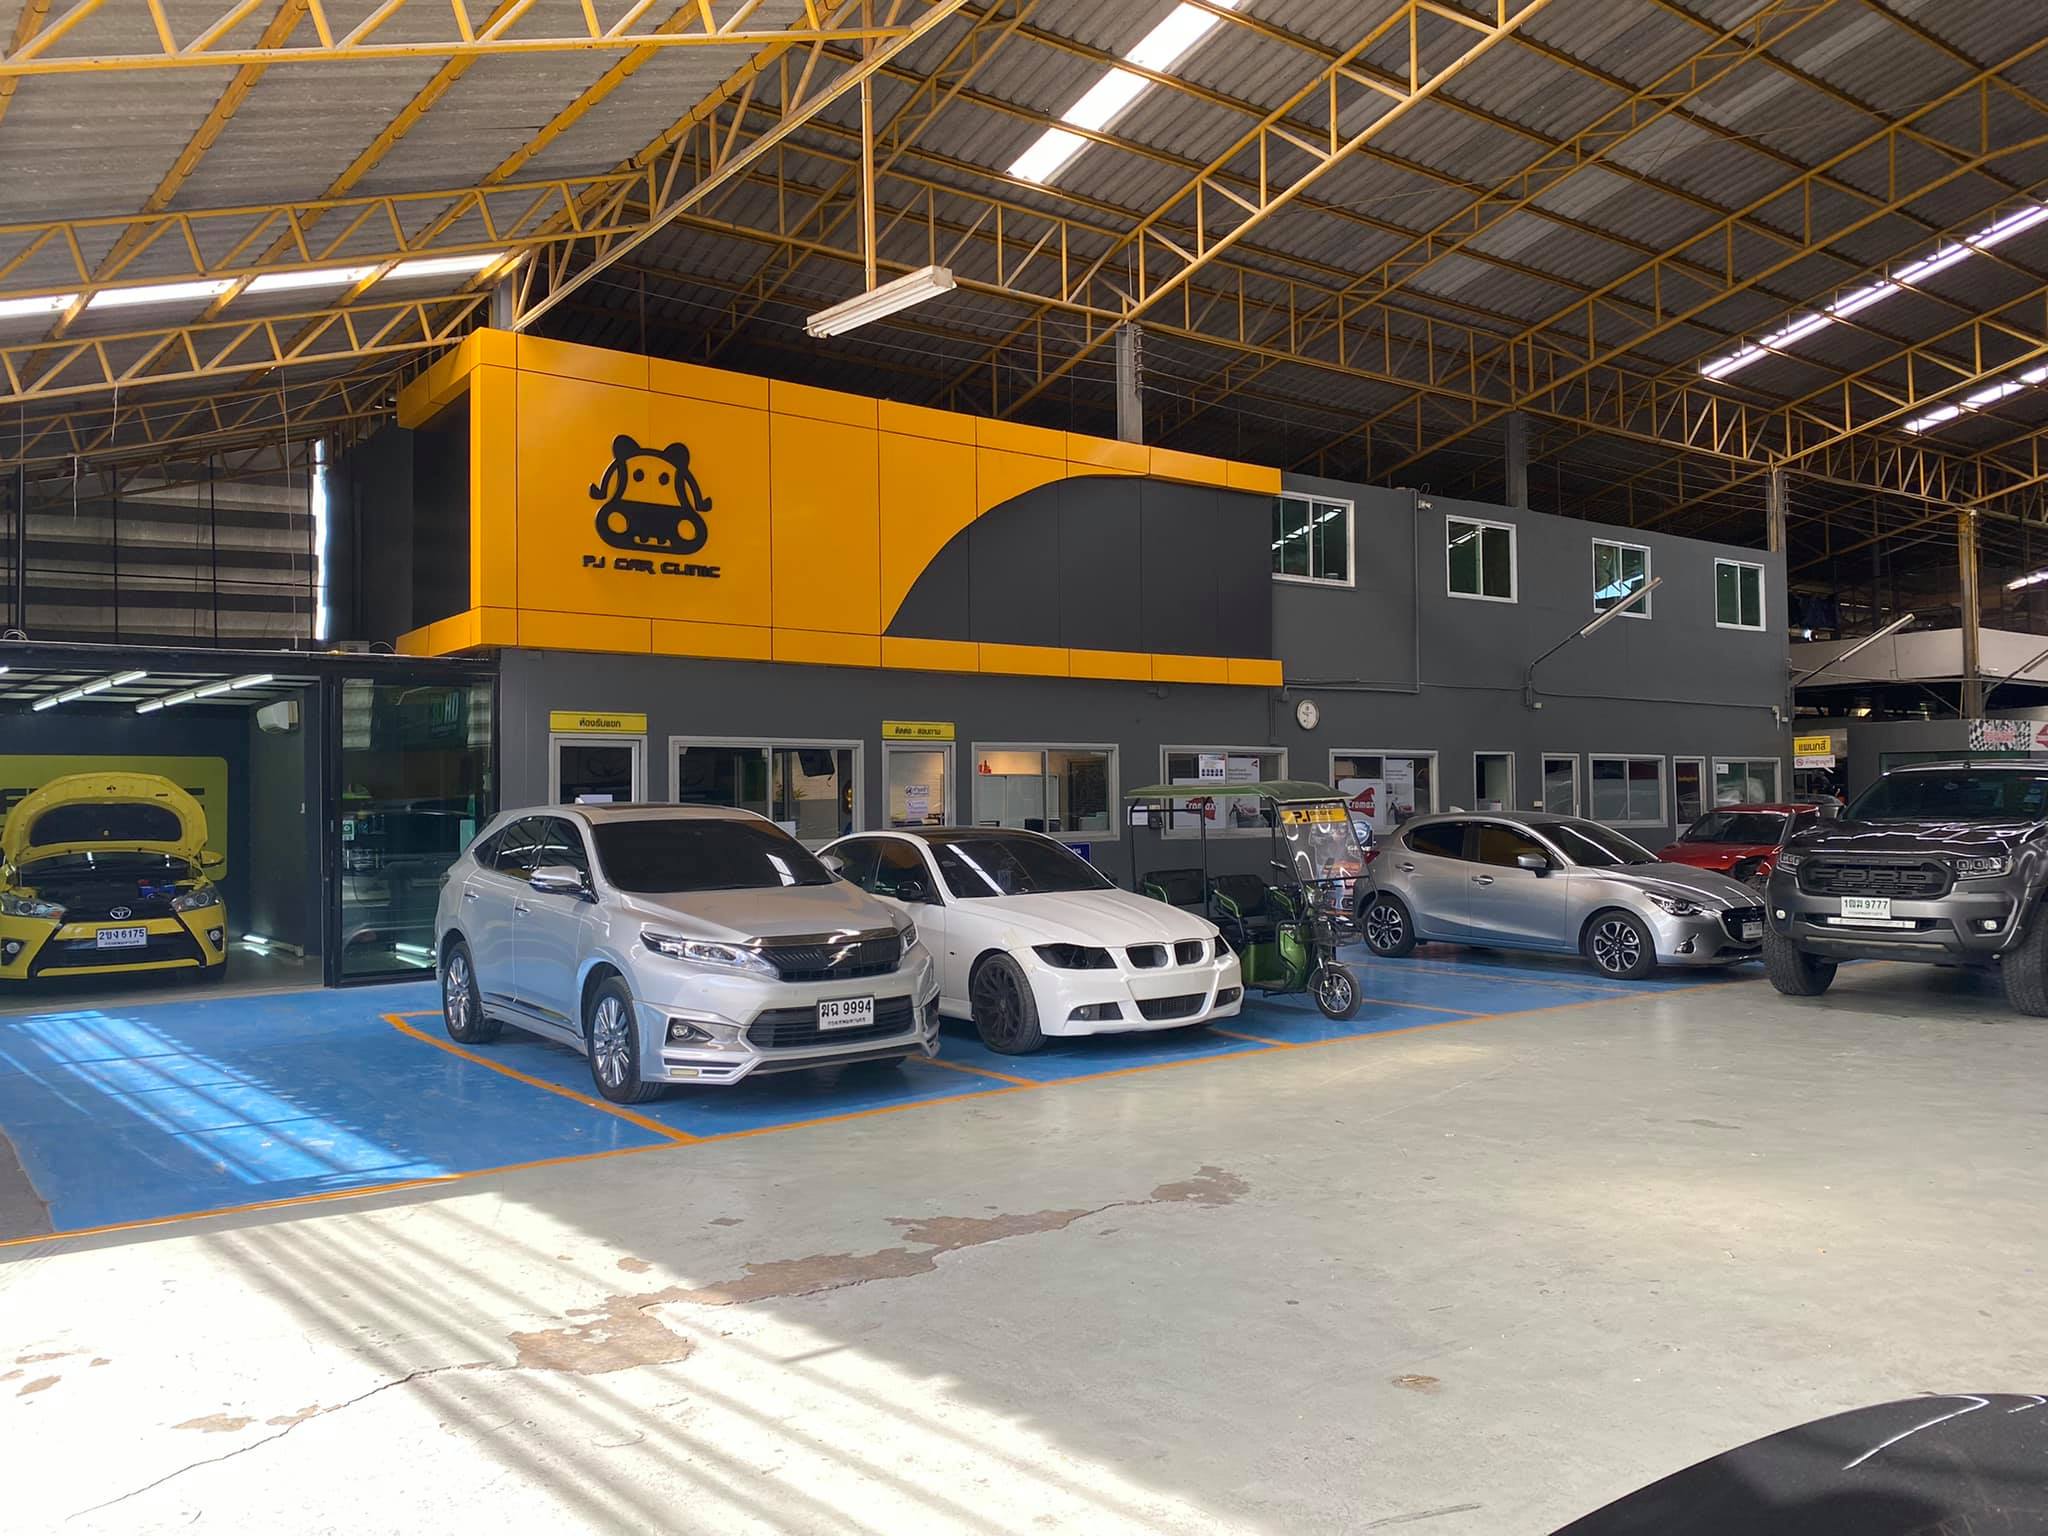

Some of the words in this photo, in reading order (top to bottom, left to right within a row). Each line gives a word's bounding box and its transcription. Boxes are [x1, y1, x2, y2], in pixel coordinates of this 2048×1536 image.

[583, 555, 605, 568] PJ
[614, 558, 656, 574] CAR
[660, 562, 720, 578] CLINIC
[579, 717, 622, 728] ห้องรับแขก
[1798, 740, 1826, 751] แผนกสี
[1812, 868, 1936, 884] FORD
[1865, 900, 1888, 909] 9777
[121, 929, 145, 938] 6175
[843, 1000, 871, 1015] 9994
